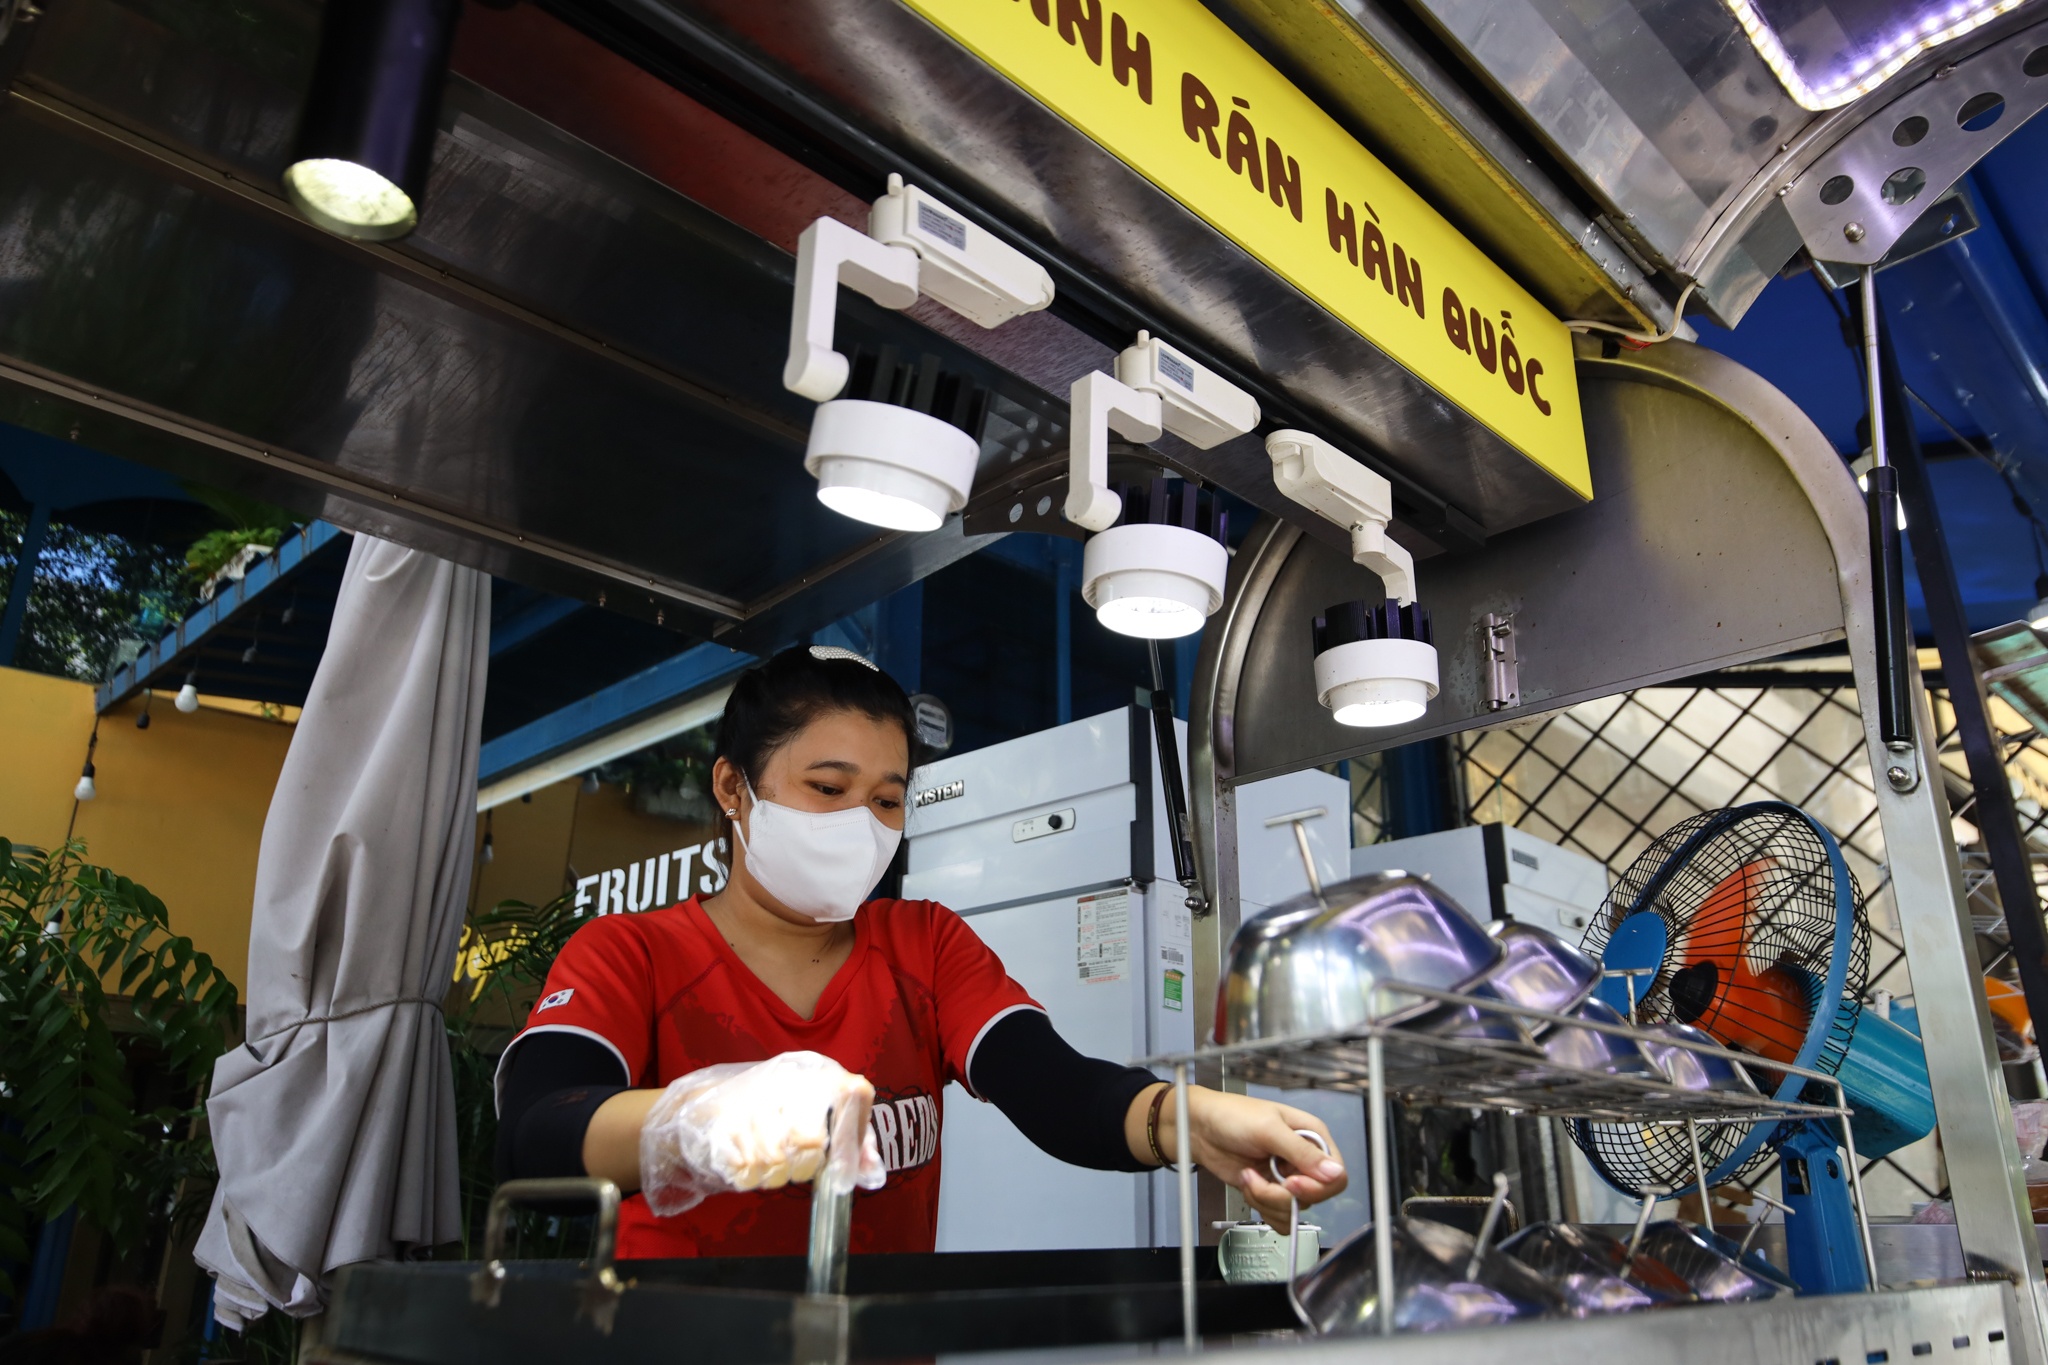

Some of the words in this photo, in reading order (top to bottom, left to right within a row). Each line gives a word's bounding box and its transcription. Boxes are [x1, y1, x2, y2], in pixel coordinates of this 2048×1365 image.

[1181, 72, 1303, 223] RÁN
[1326, 187, 1425, 320] HÀN
[1442, 286, 1552, 417] QUỐC
[915, 779, 964, 808] KISTEM
[573, 837, 729, 918] FRUITS
[871, 1094, 938, 1172] REDS
